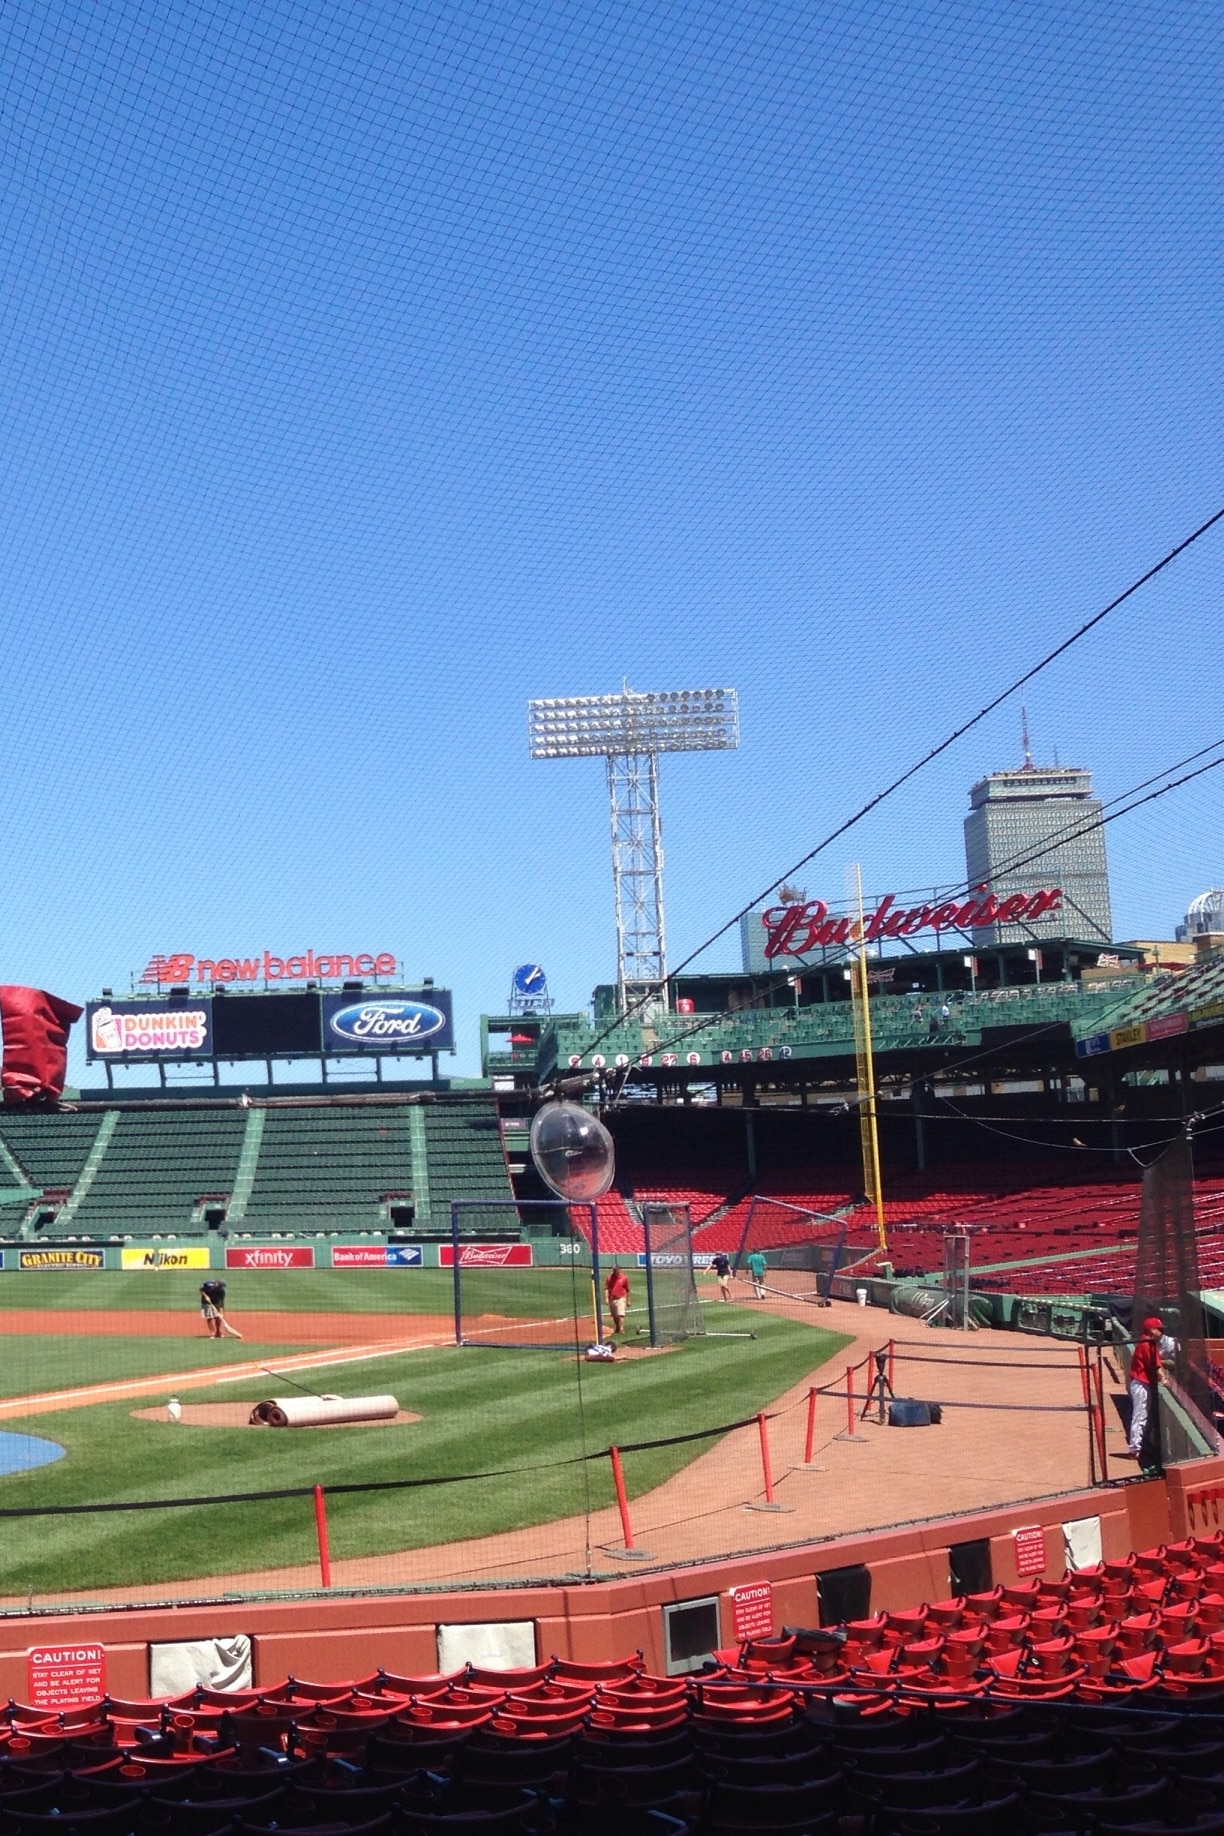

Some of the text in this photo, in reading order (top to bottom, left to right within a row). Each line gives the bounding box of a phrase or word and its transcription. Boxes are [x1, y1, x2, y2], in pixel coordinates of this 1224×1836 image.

[762, 884, 1064, 957] Budweiser
[264, 949, 396, 980] balance
[353, 1006, 422, 1035] Ford
[125, 1031, 200, 1047] DONUTS
[22, 1252, 103, 1267] GRANITE CITY
[245, 1250, 293, 1268] xfinity
[334, 1252, 353, 1261] Bank
[364, 1251, 398, 1261] America
[736, 1586, 770, 1602] CAUTION!
[32, 1649, 101, 1664] CAUTION!
